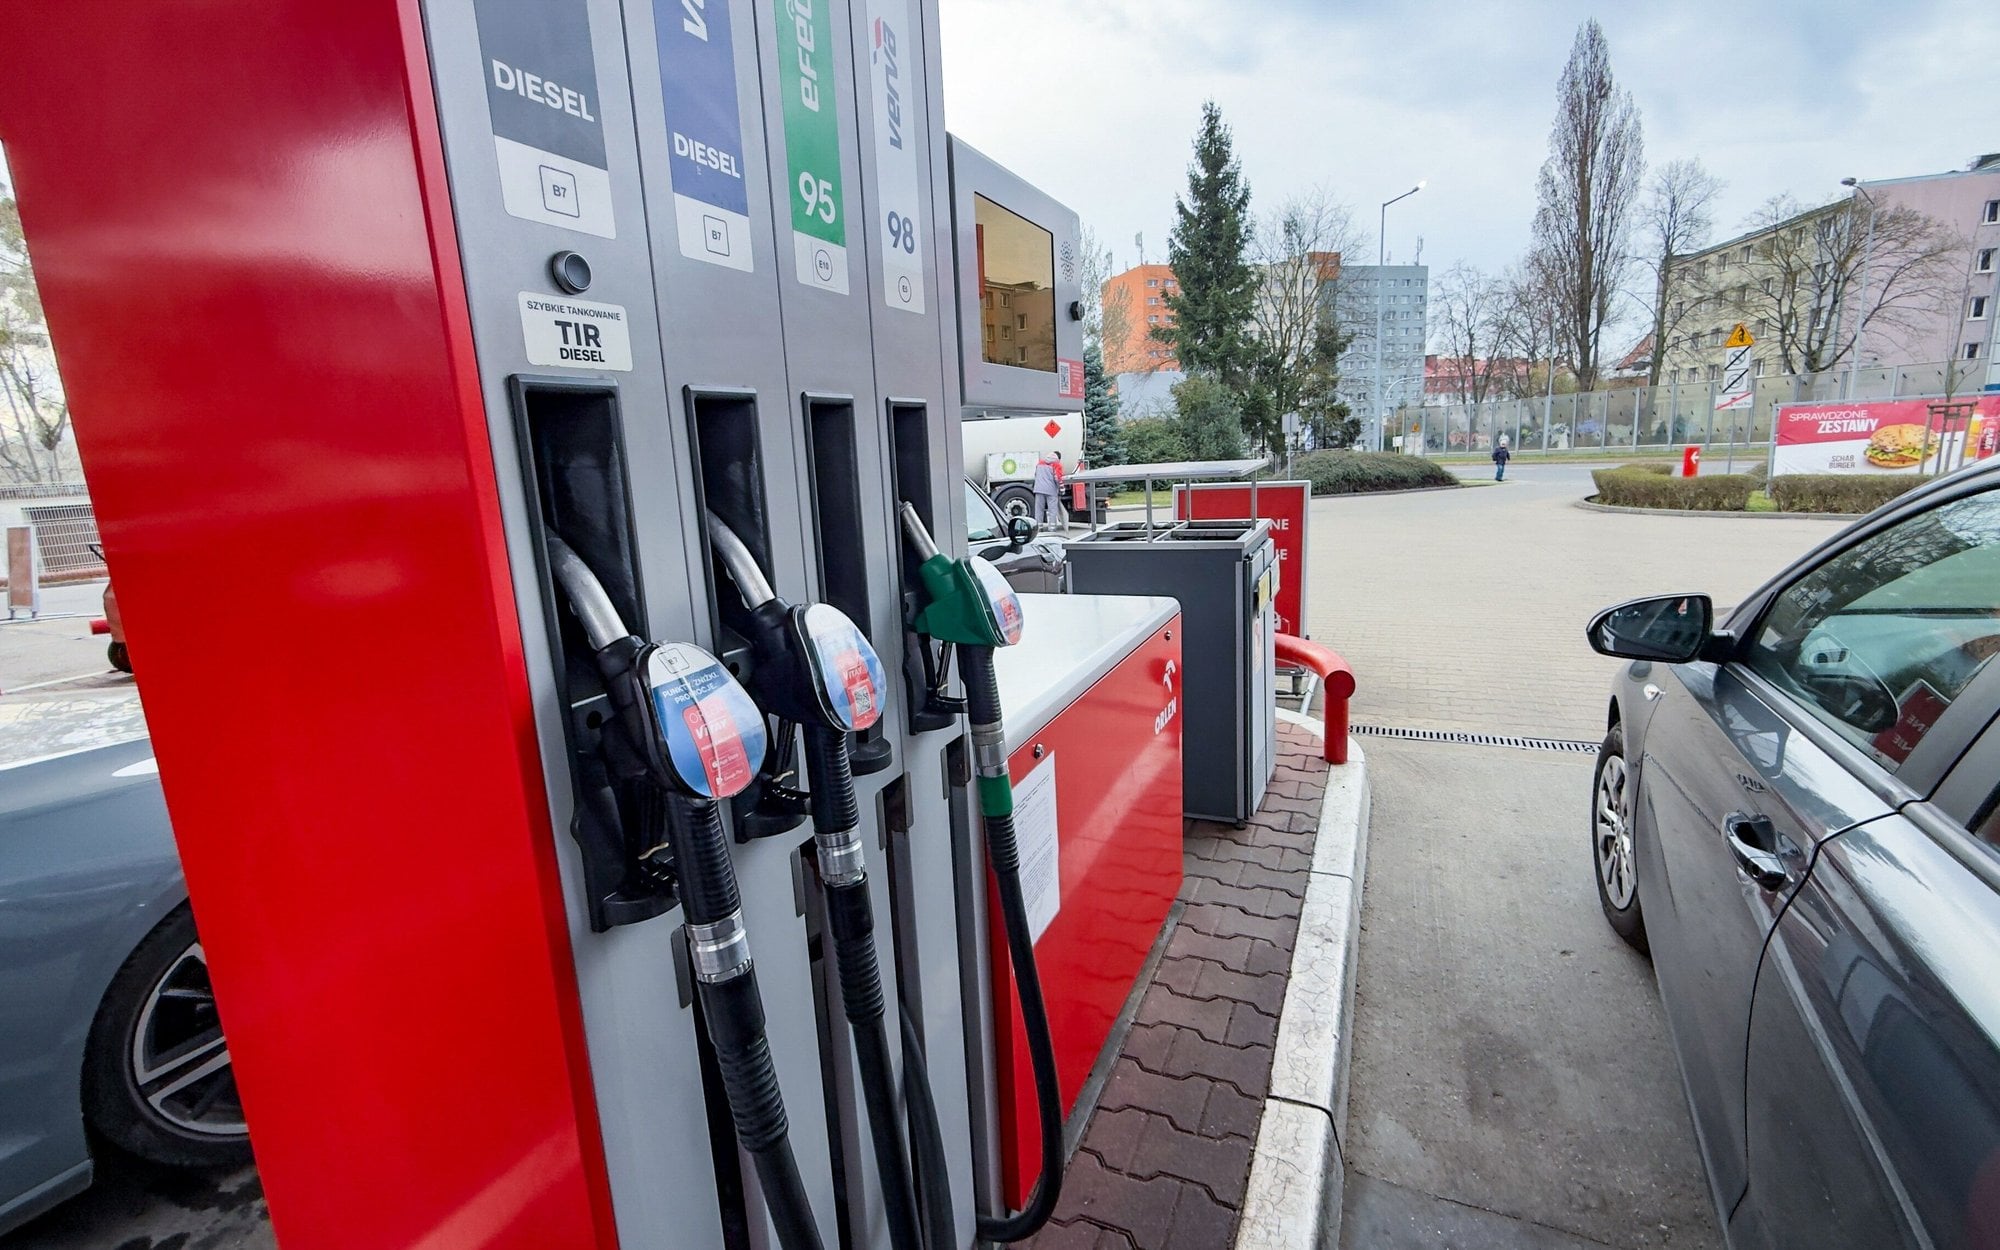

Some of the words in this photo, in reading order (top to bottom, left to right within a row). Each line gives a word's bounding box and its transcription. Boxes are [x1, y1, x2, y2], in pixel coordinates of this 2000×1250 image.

[491, 58, 595, 123] DIESEL
[673, 131, 741, 179] DIESEL
[552, 183, 568, 199] B7
[798, 171, 836, 225] 95
[711, 229, 722, 241] B7
[887, 210, 915, 255] 98
[818, 260, 829, 271] E10
[527, 300, 566, 314] SZYBKIE
[567, 305, 621, 321] TANKOWANIE
[554, 320, 602, 348] TIR
[560, 347, 606, 362] DIESEL
[1789, 410, 1868, 422] SPRAWDZONE
[1817, 418, 1879, 434] ZESTAWY
[1829, 461, 1856, 469] BURGER
[1154, 696, 1177, 736] ORLEN
